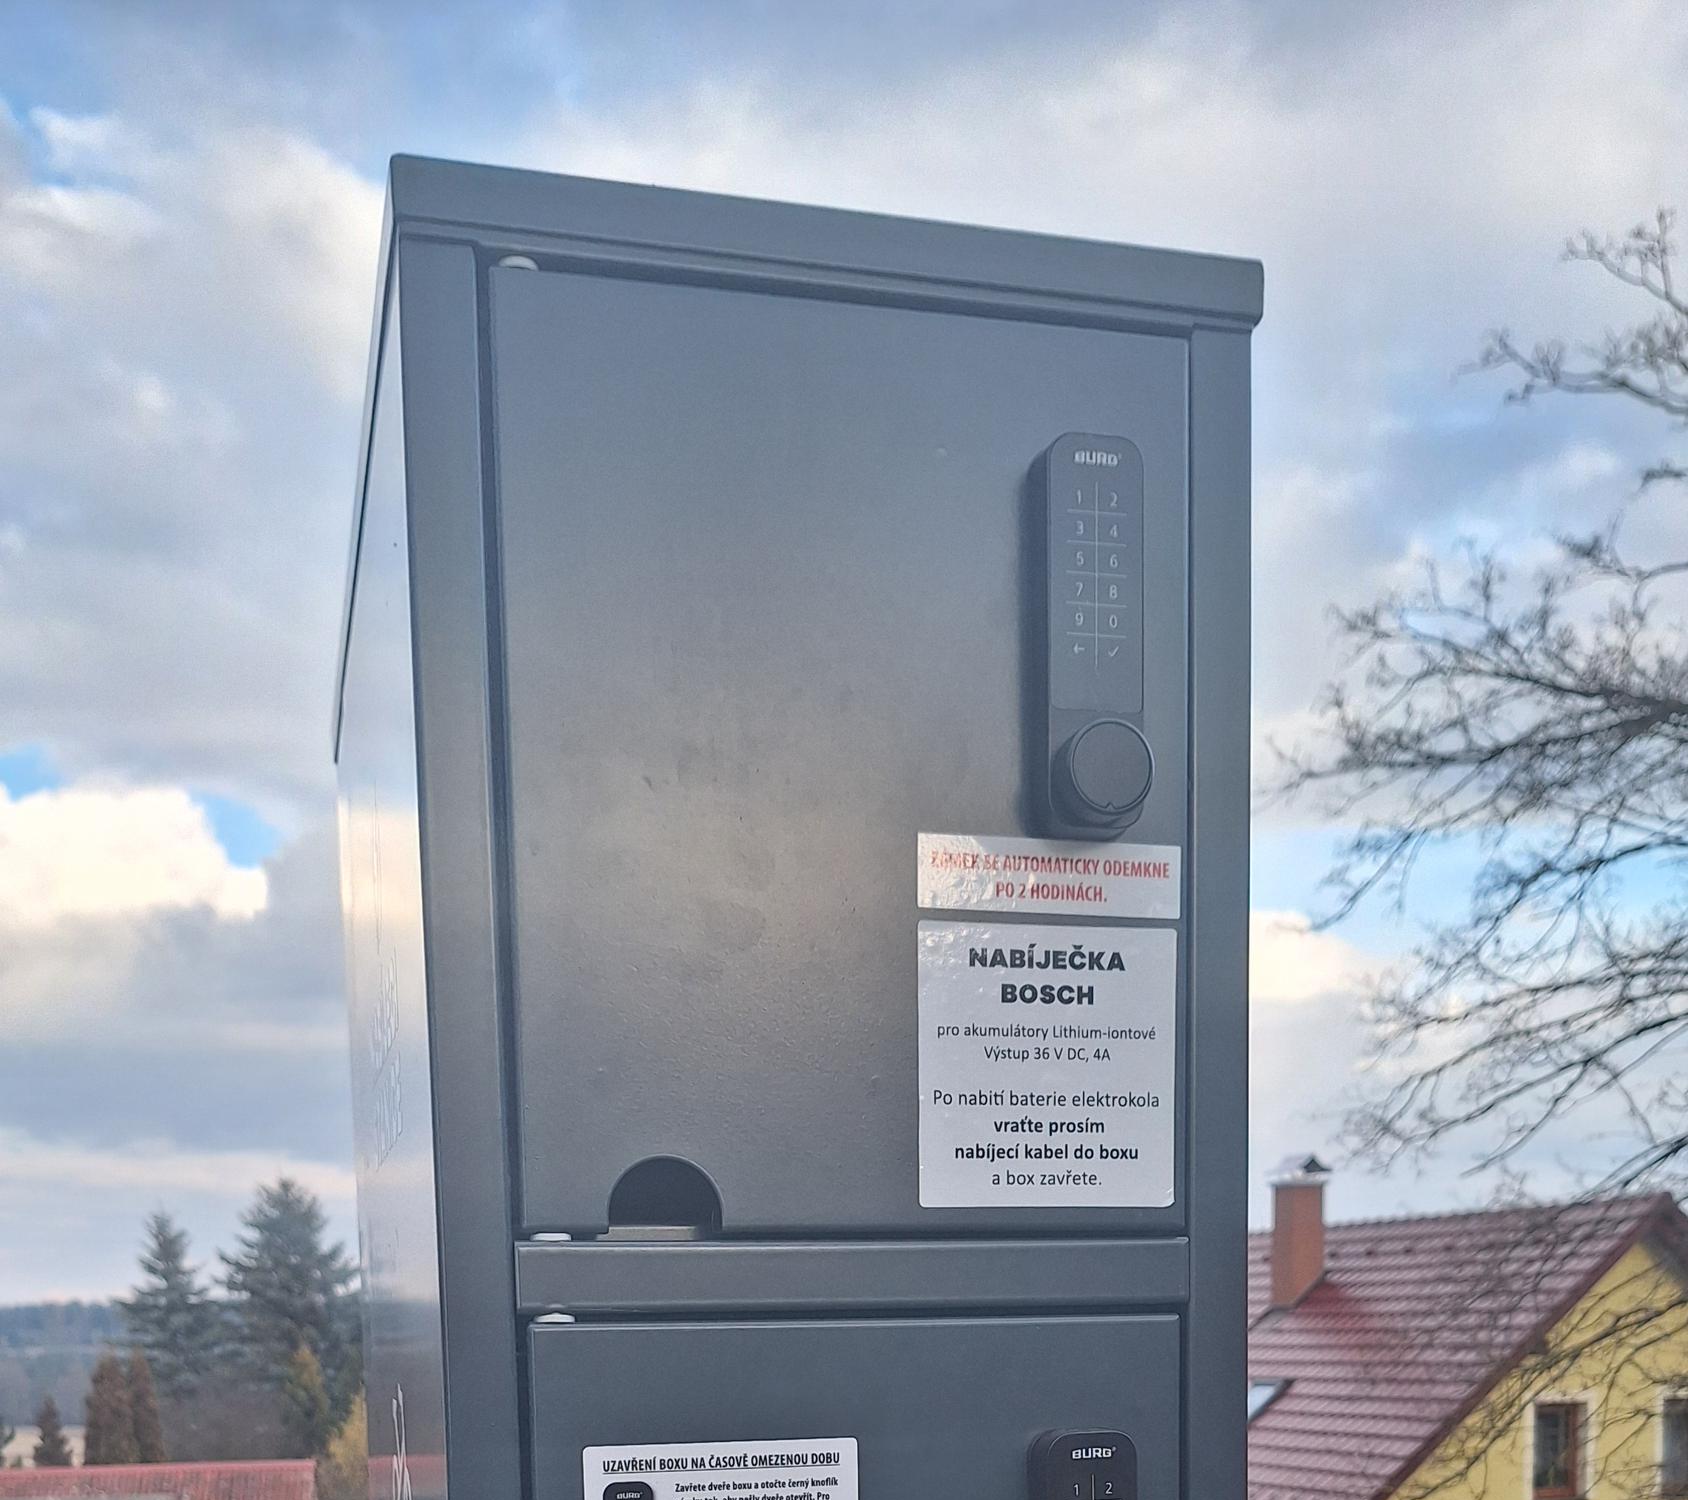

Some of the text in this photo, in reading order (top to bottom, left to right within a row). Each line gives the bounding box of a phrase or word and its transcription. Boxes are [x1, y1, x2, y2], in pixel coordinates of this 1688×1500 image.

[1002, 853, 1100, 876] AUTOMATICKY
[1103, 859, 1170, 879] ODEMKNE
[995, 881, 1108, 903] PO 2 HODINÁCH.
[969, 943, 1126, 972] NABÍJEČKA
[1000, 983, 1094, 1006] BOSCH
[937, 1022, 1156, 1042] pro akumulátory Lithium-iontové
[983, 1045, 1111, 1063] Výstup 36 V DC, 4A
[933, 1089, 1160, 1108] Po nabití baterie elektrokola
[993, 1115, 1105, 1137] vraťte prosím
[955, 1142, 1139, 1163] nabíjecí kabel do boxu
[991, 1169, 1102, 1186] a box zavřete.
[602, 1451, 840, 1472] UZAVŘENÍ BOXU NA ČASOVĚ OMEZENOU DOBU
[732, 1481, 753, 1491] boxu
[753, 1482, 759, 1490] a
[1073, 1482, 1113, 1496] 1 2
